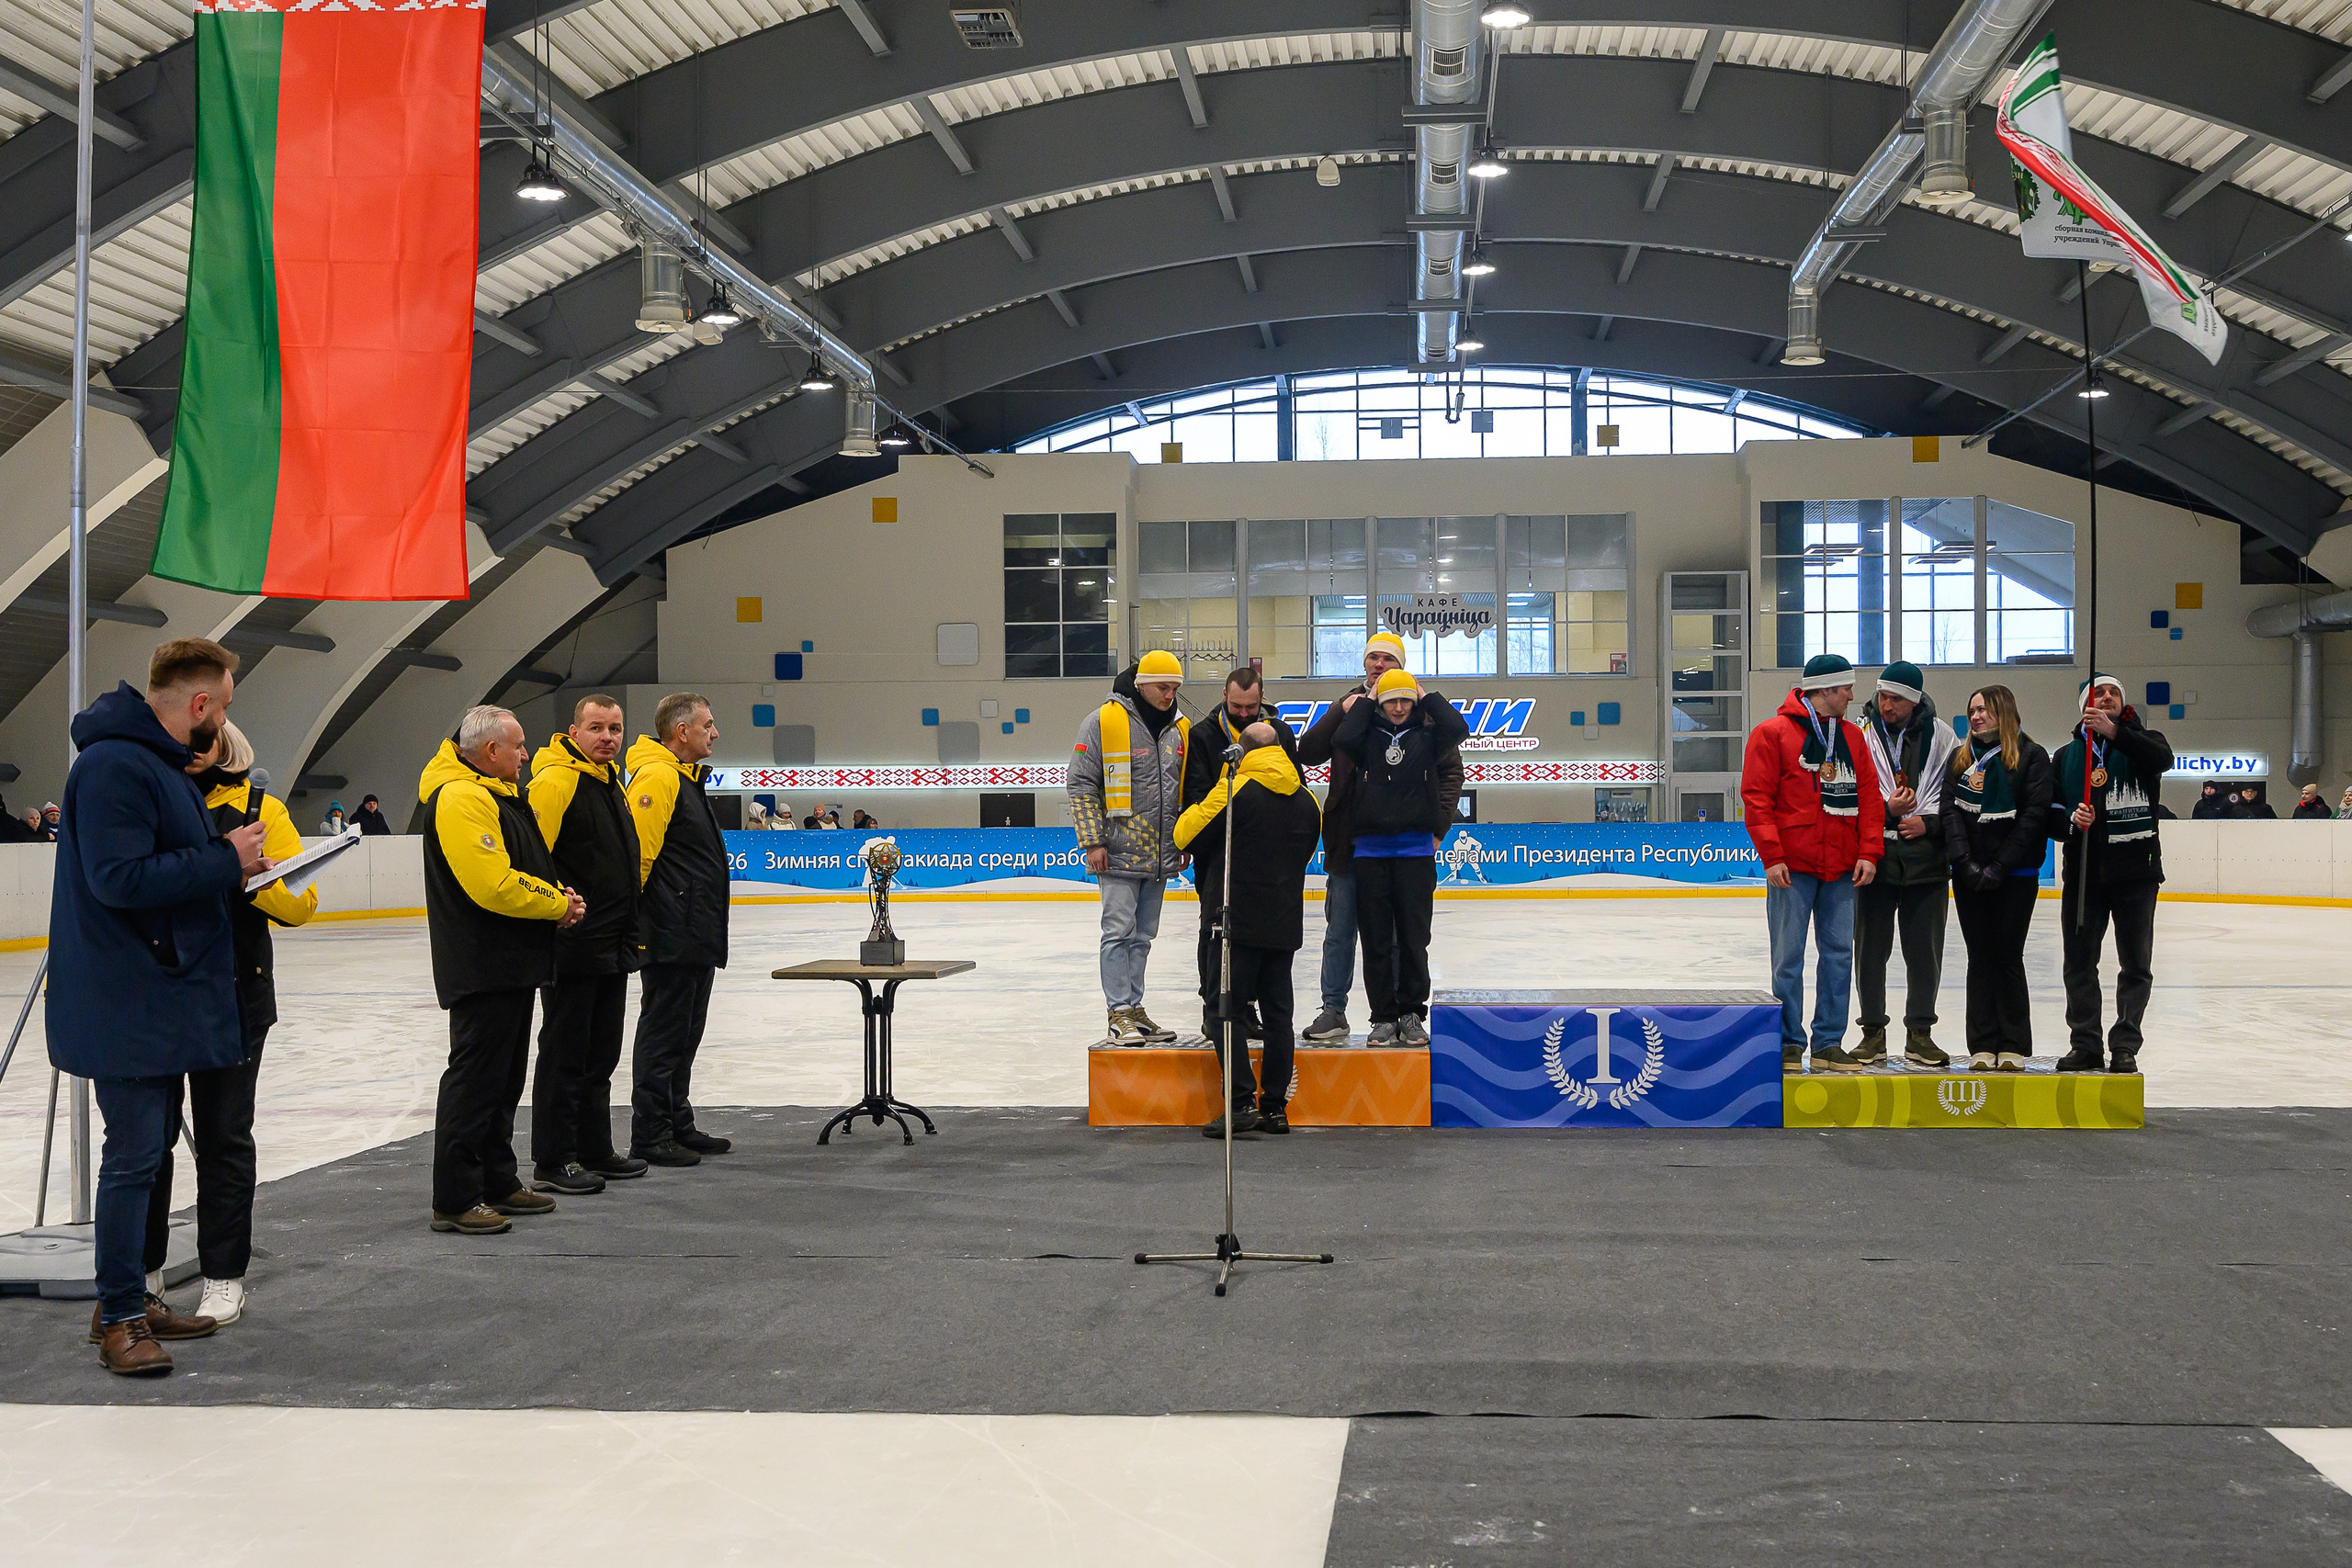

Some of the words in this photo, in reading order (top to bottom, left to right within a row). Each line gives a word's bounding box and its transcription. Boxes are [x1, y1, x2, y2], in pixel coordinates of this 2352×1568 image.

[2054, 224, 2084, 233] сборная
[2053, 235, 2100, 243] учреждений
[1418, 598, 1458, 607] КАФЕ
[1384, 606, 1492, 635] Чараўніца
[1497, 739, 1537, 750] ЦЕНТР
[764, 851, 841, 870] Зимняя
[978, 852, 1038, 872] среди
[1514, 845, 1636, 868] Президента
[1585, 1008, 1622, 1084] I
[1945, 1080, 1979, 1102] III
